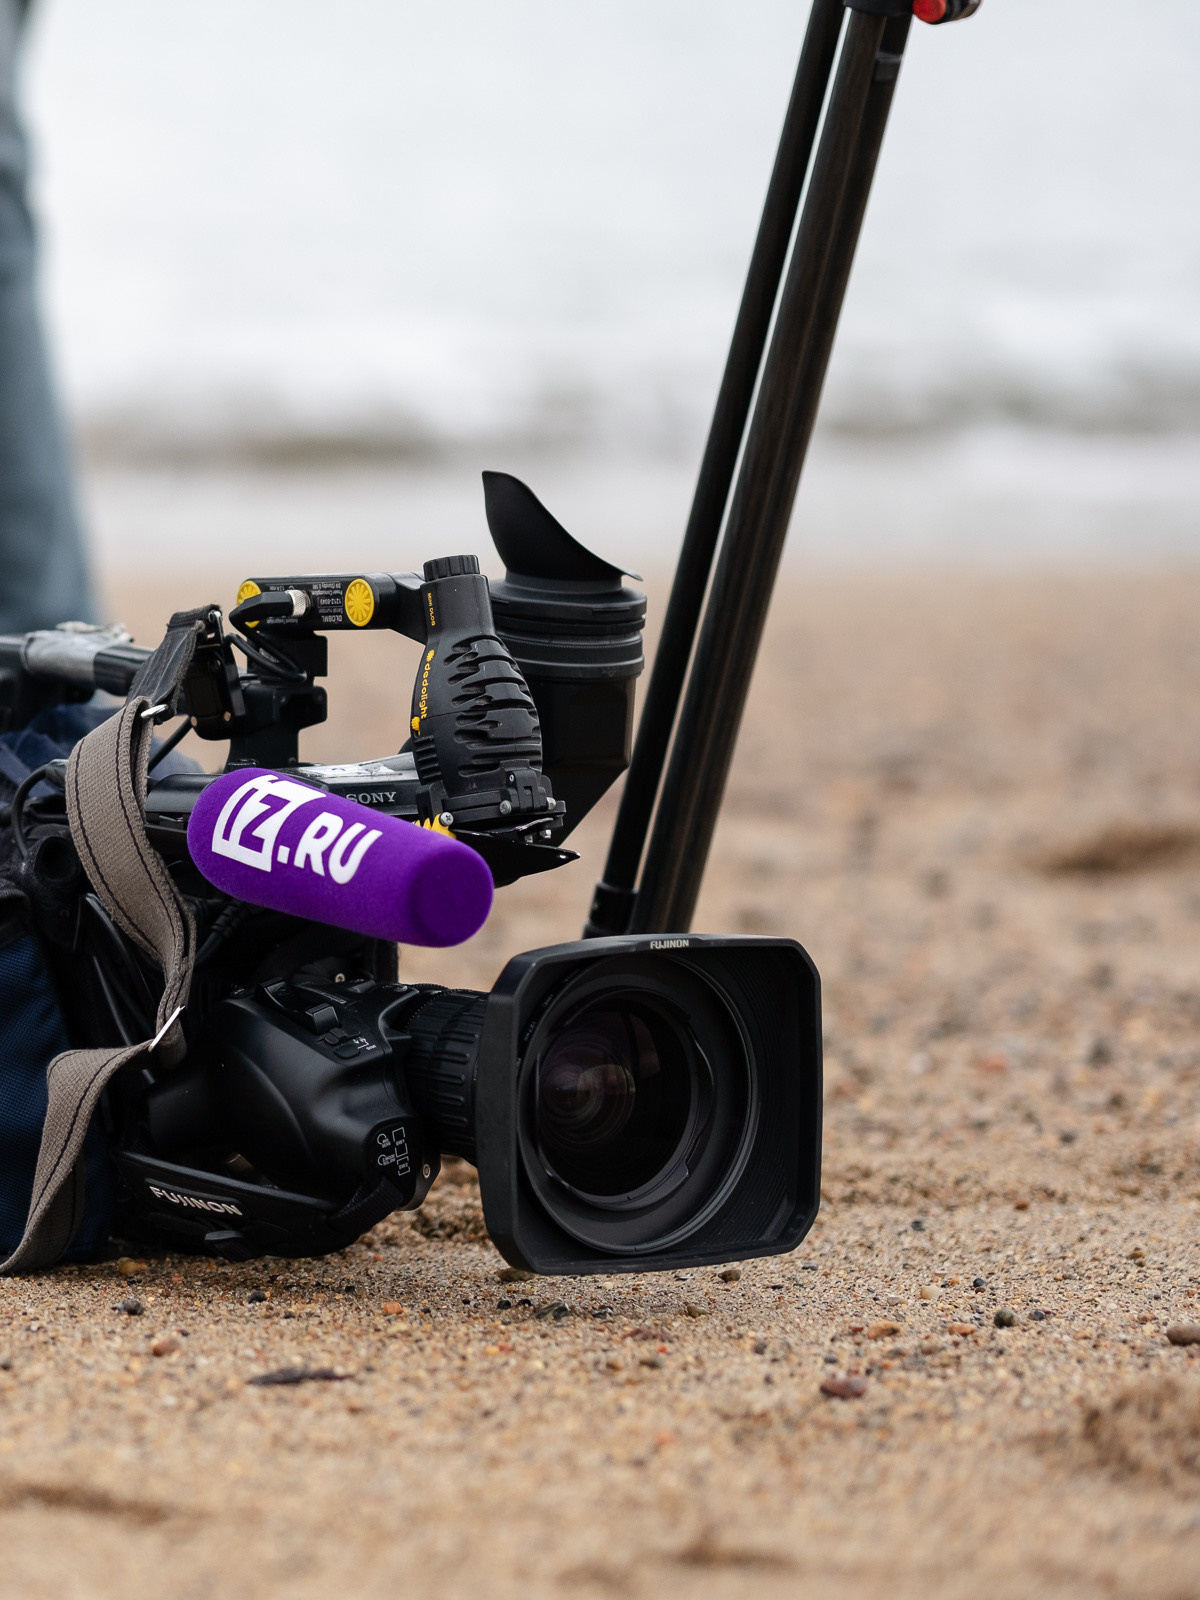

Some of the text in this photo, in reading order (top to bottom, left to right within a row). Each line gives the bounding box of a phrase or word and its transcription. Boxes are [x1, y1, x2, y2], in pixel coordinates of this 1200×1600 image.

[419, 662, 431, 719] dedolight
[346, 791, 397, 804] SONY
[650, 939, 690, 949] FUJINON
[149, 1186, 243, 1216] FUJINON
